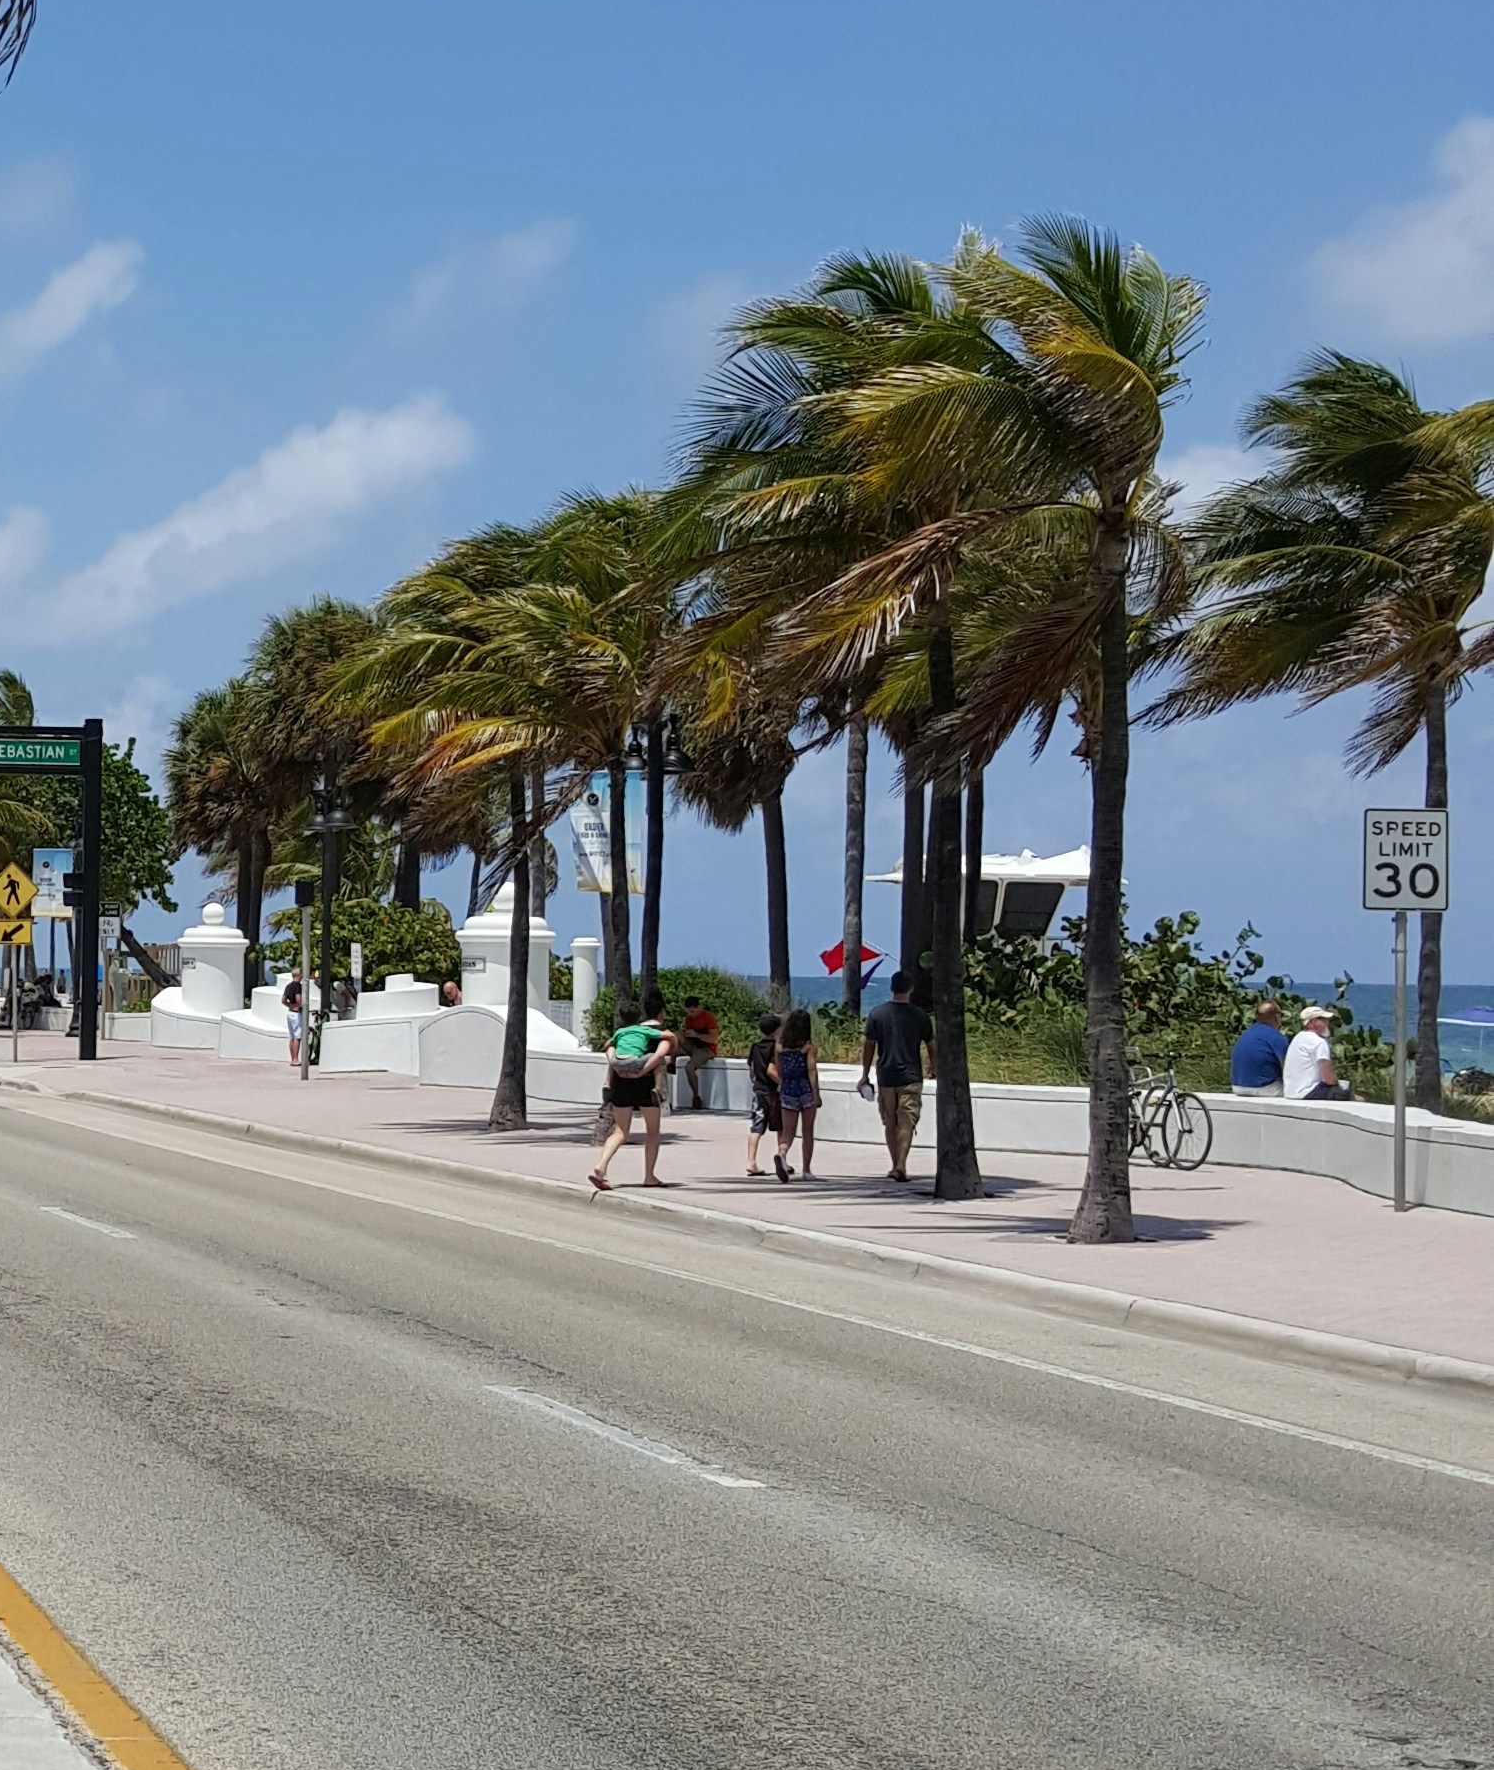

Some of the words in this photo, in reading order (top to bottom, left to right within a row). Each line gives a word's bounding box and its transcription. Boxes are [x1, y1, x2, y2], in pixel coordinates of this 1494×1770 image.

[1372, 821, 1442, 837] SPEED
[1379, 842, 1434, 857] LIMIT
[1373, 862, 1440, 899] 30
